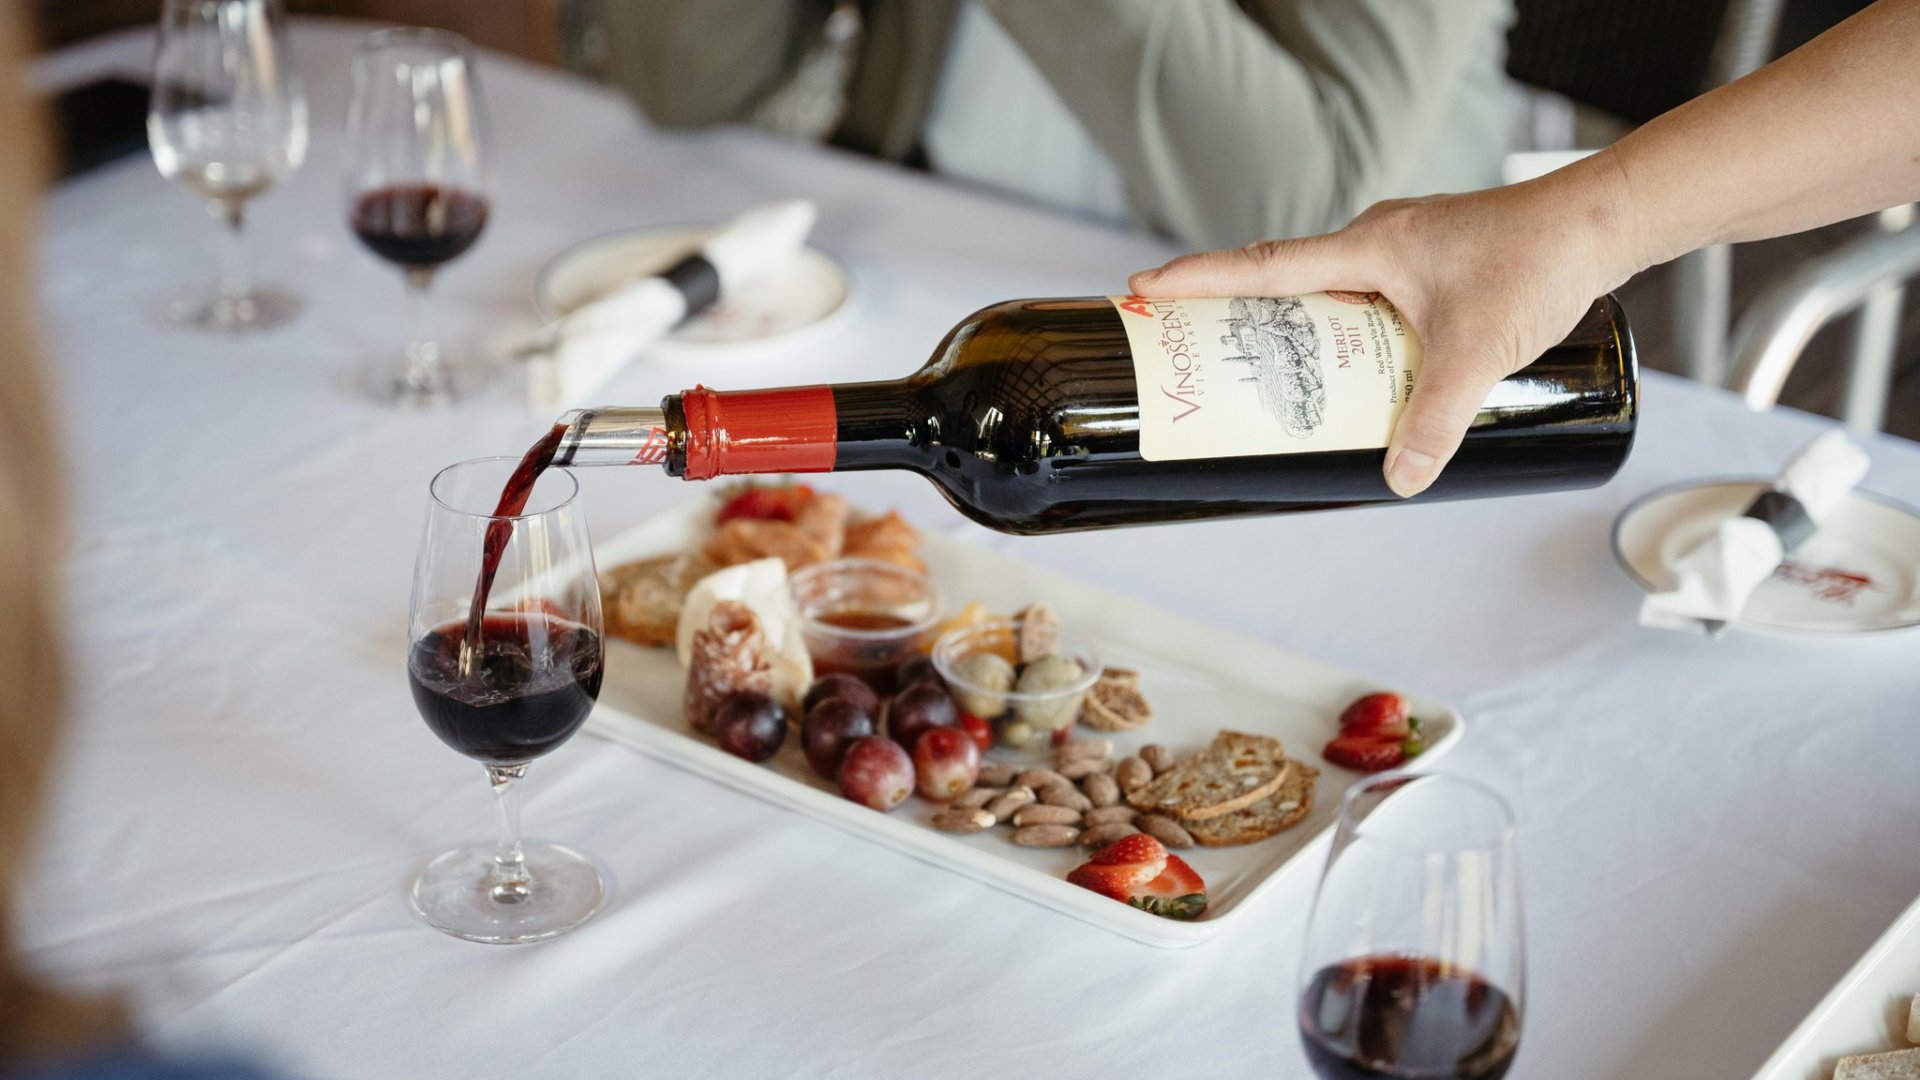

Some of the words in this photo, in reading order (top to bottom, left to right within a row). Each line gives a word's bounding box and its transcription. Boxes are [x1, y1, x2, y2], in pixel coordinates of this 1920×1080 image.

[1176, 305, 1206, 397] VINEYARDS
[1327, 315, 1351, 369] MERLOT
[1346, 326, 1365, 355] 2011
[1377, 359, 1385, 375] Red
[1387, 365, 1394, 374] of
[1403, 369, 1413, 382] ml
[1389, 374, 1397, 403] Product
